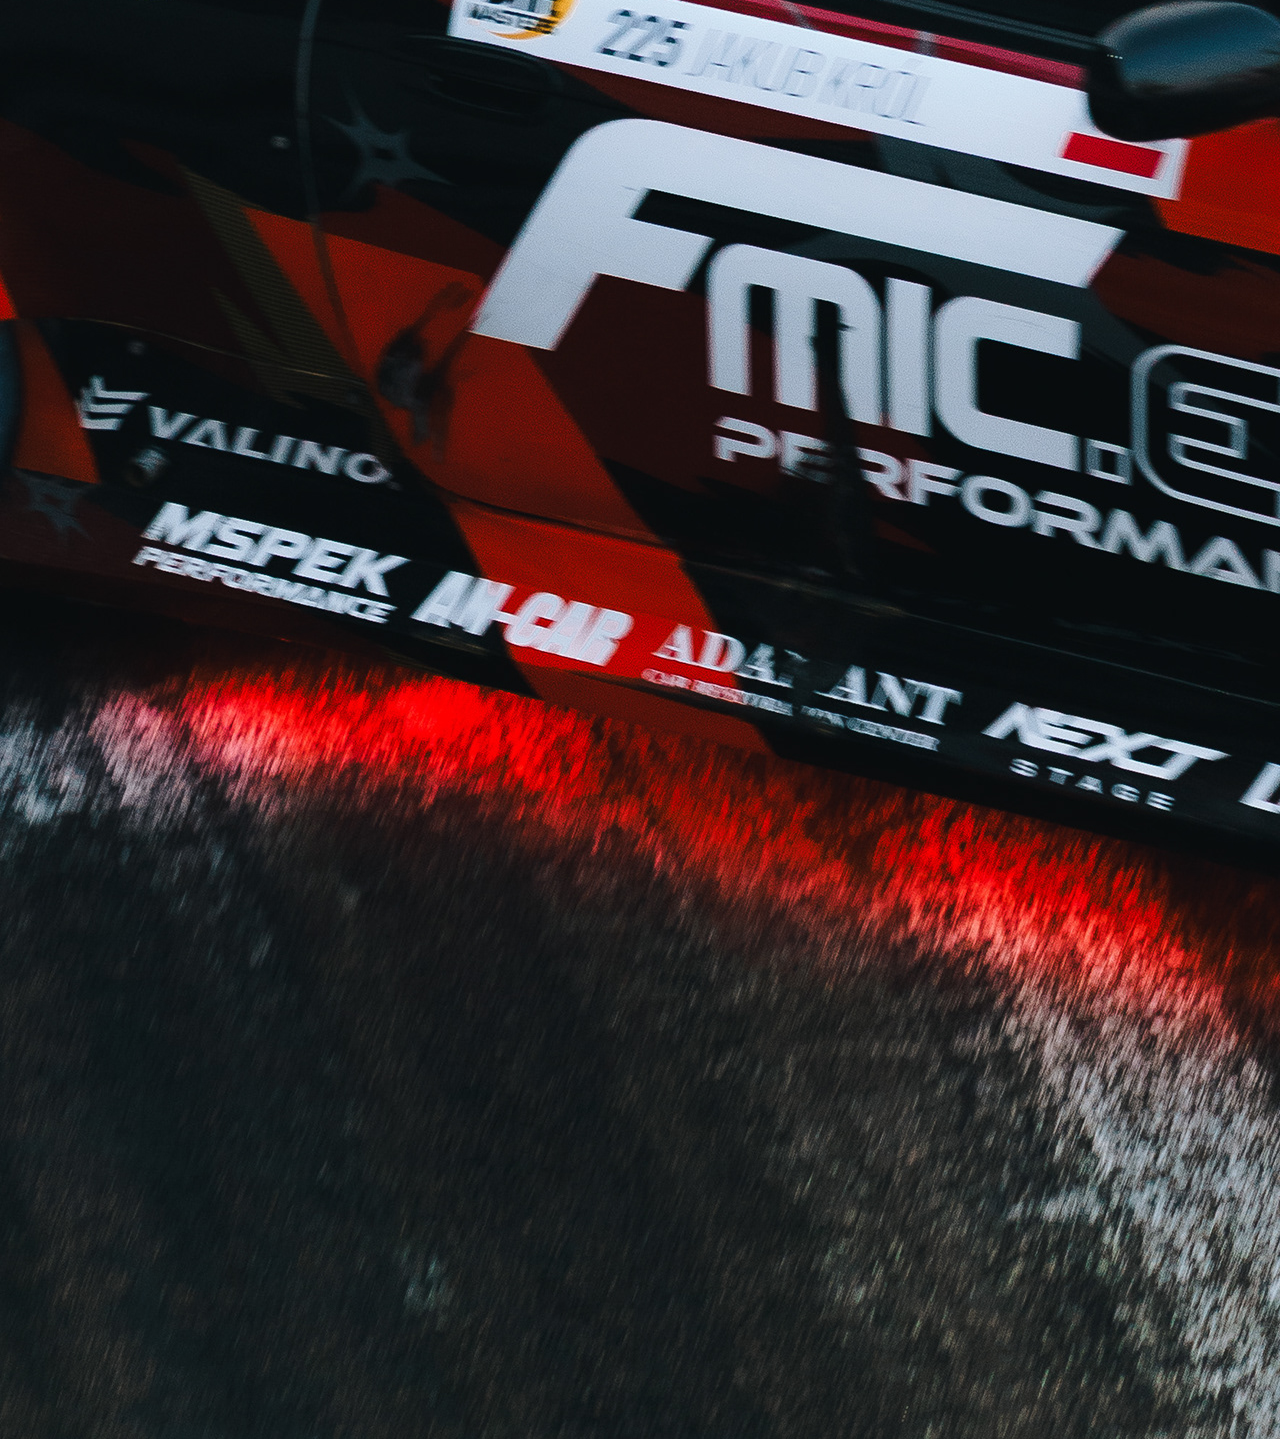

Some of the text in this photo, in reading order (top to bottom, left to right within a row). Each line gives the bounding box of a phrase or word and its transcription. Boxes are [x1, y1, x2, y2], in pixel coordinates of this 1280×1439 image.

[595, 8, 691, 67] 225
[687, 28, 824, 97] JAKUB
[149, 405, 394, 487] VALINO
[132, 545, 396, 624] PERFORMANCE
[141, 501, 411, 596] MSPEK
[1008, 758, 1176, 813] STAGE
